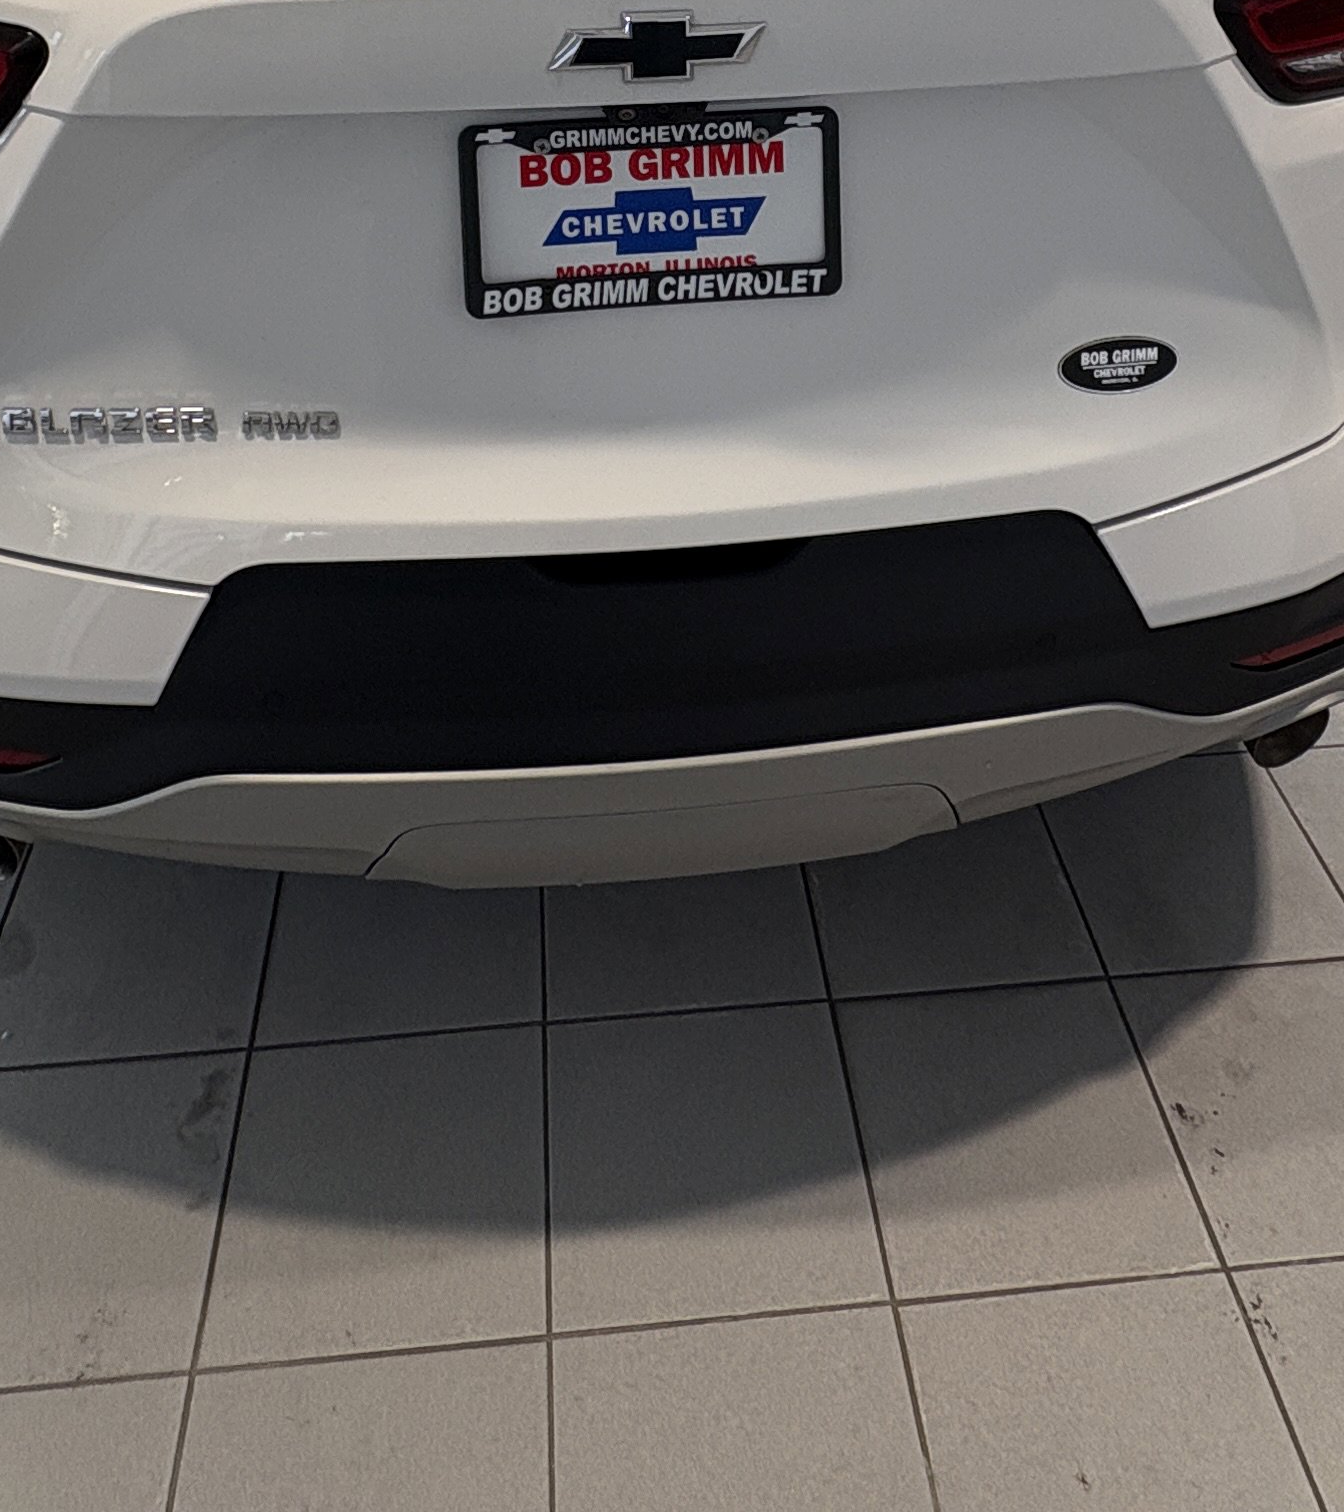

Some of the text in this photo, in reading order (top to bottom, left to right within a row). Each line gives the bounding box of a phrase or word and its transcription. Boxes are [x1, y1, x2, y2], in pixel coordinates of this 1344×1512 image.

[549, 121, 752, 149] GRIMMCHEVY.COM
[519, 140, 785, 188] BOB GRIMM
[561, 206, 745, 239] CHEVROLET
[482, 268, 828, 315] BOB GRIMM CHEVROLET
[1080, 346, 1159, 366] BOB GRIMM
[1093, 365, 1146, 379] CHEVROLET
[1, 405, 342, 442] BLAZER AWD
